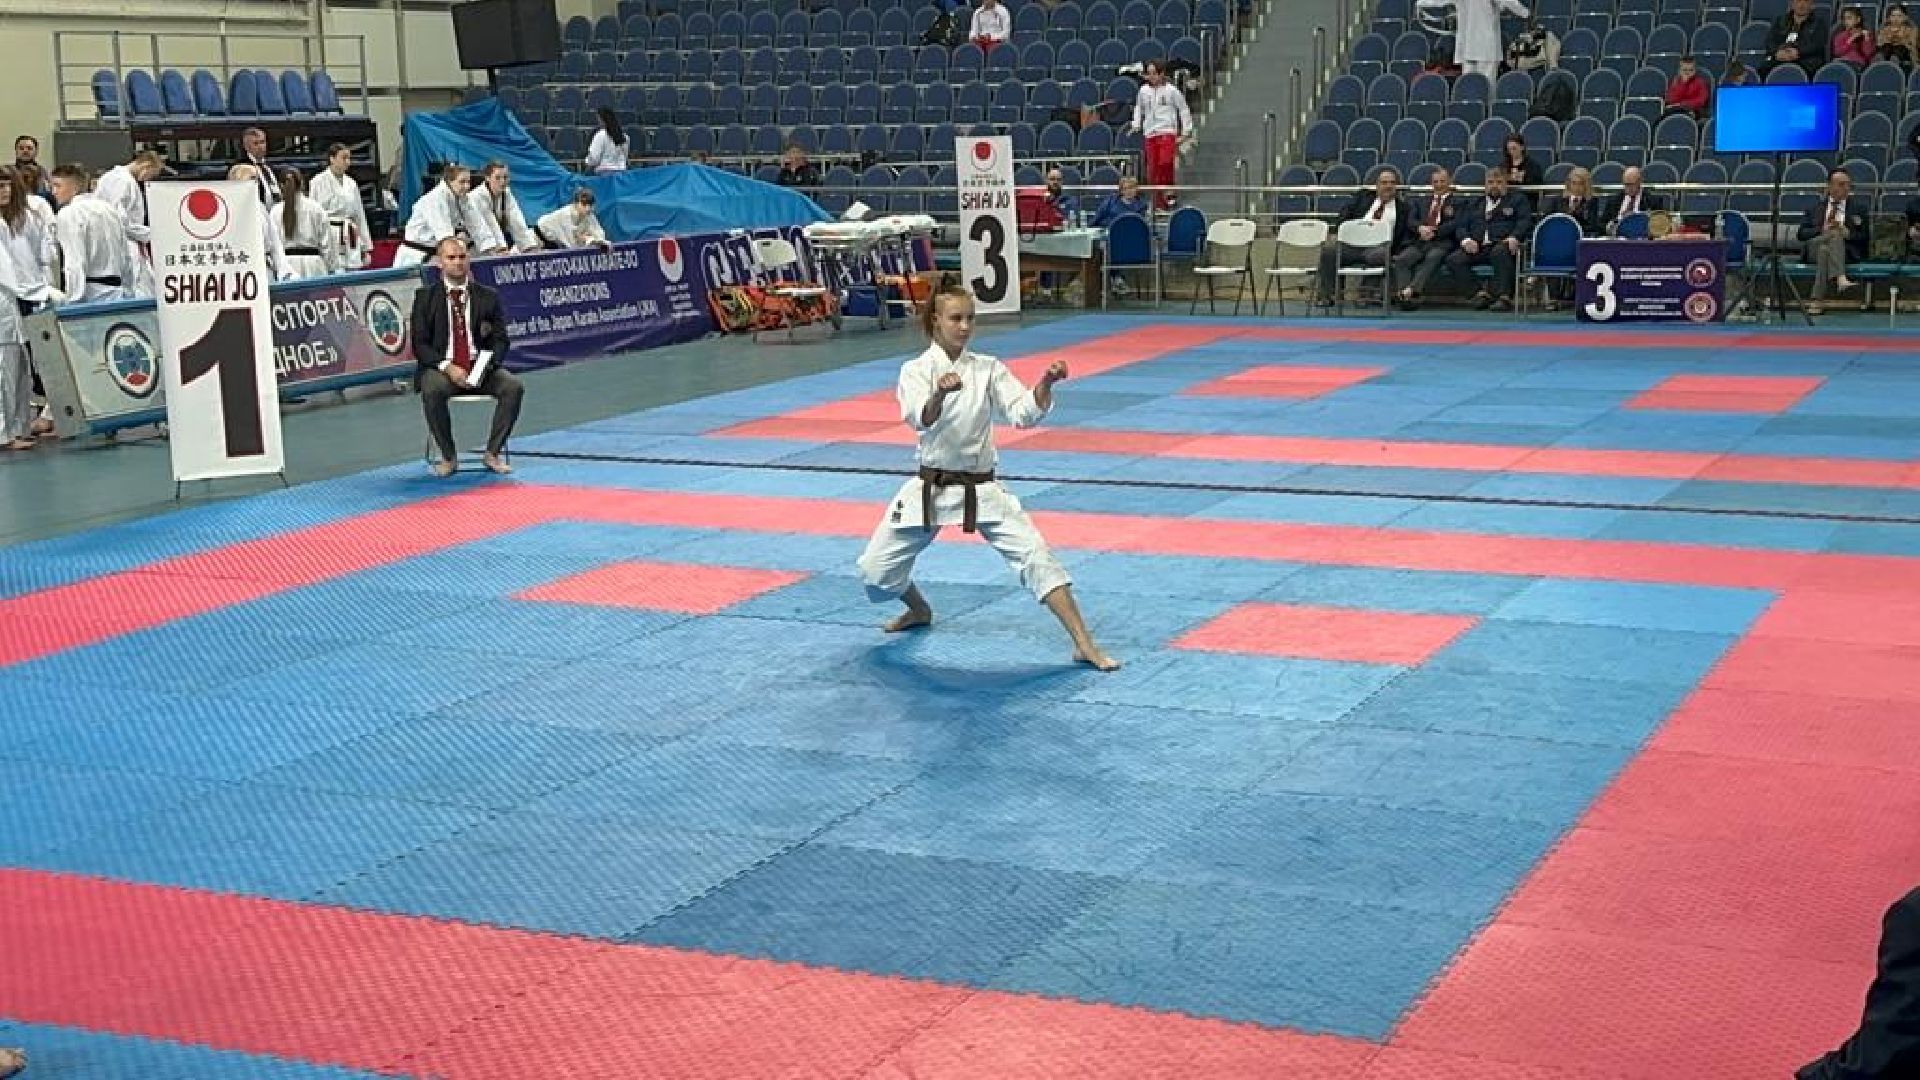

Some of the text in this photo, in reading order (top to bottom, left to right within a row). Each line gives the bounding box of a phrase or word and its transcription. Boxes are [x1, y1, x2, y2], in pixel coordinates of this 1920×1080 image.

[961, 190, 1010, 210] SHIAI JO
[493, 263, 525, 285] UNION
[525, 261, 537, 282] OF
[969, 215, 1009, 303] 3
[164, 270, 258, 304] SHIAI JO
[1585, 261, 1617, 321] 3
[273, 297, 359, 331] СПОРТА
[272, 340, 338, 378] ДНОЕ»
[178, 307, 265, 458] 1
